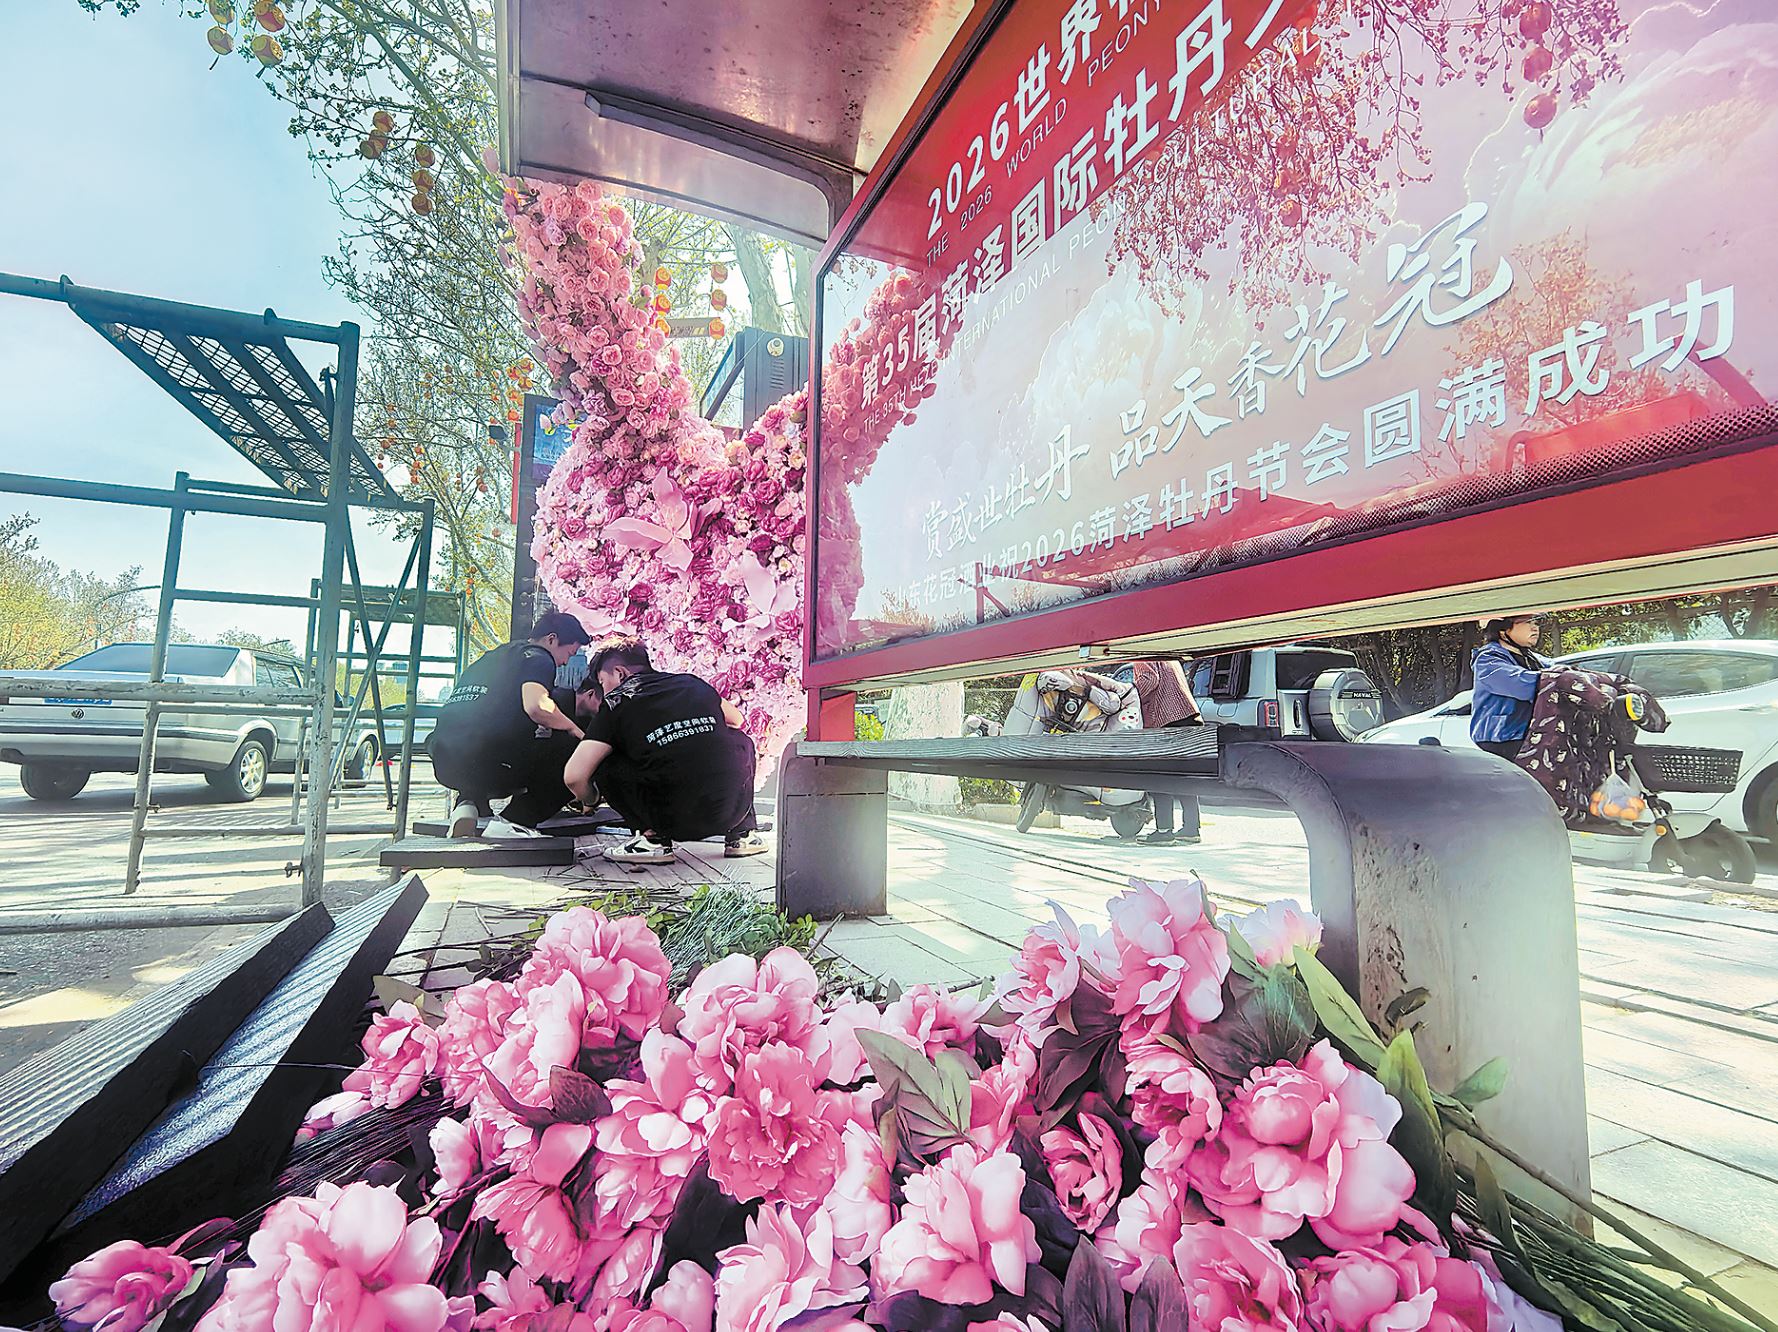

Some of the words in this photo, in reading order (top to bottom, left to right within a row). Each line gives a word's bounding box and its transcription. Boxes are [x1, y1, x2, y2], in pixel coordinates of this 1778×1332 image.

[860, 0, 1285, 411] 第35届菏泽国际牡丹
[926, 232, 950, 268] THE
[960, 185, 993, 232] 2026
[1006, 97, 1067, 179] WORLD
[927, 0, 1135, 241] 2026世界
[863, 408, 880, 434] THE
[882, 384, 906, 419] 35TH
[942, 253, 1061, 368] INTERNATIONAL
[1069, 157, 1146, 261] PEONY
[922, 424, 1090, 562] 赏盛世牡丹
[1108, 201, 1515, 480] 品天香花冠
